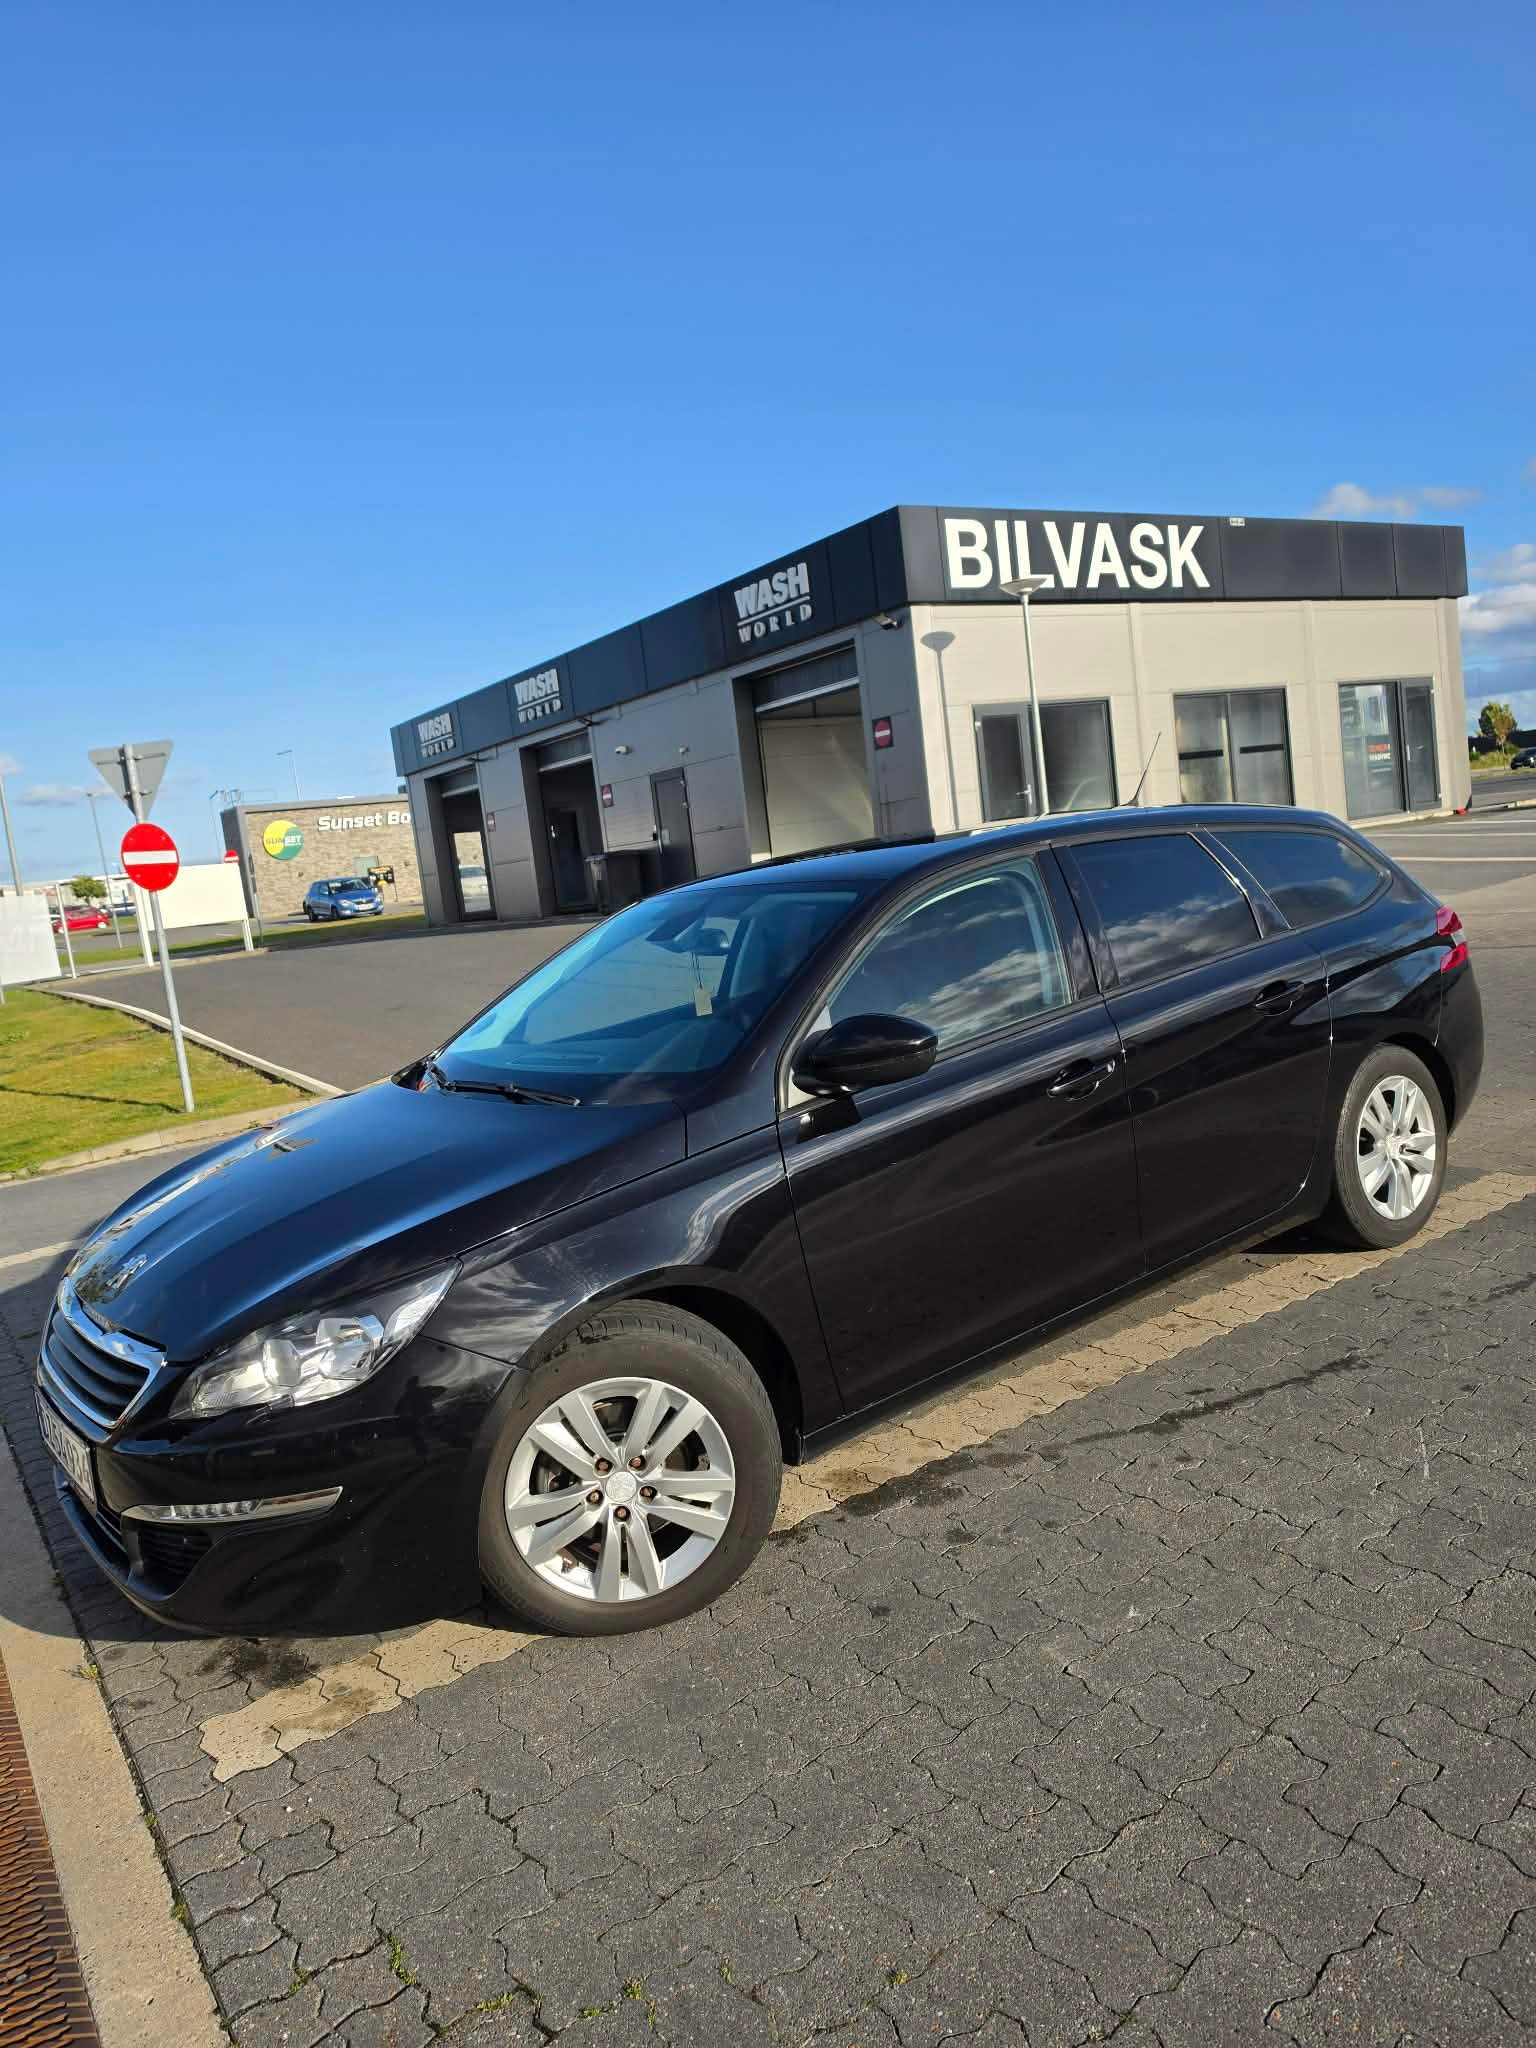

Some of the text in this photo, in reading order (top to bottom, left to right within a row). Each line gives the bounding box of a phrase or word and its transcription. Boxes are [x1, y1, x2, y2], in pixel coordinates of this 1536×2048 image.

[944, 518, 1211, 589] BILVASK
[734, 562, 810, 619] WASH
[738, 604, 812, 643] WORLD
[514, 668, 559, 705] WASH
[418, 713, 452, 742] WASH
[518, 699, 561, 723] WORLD
[318, 812, 383, 831] Sunset
